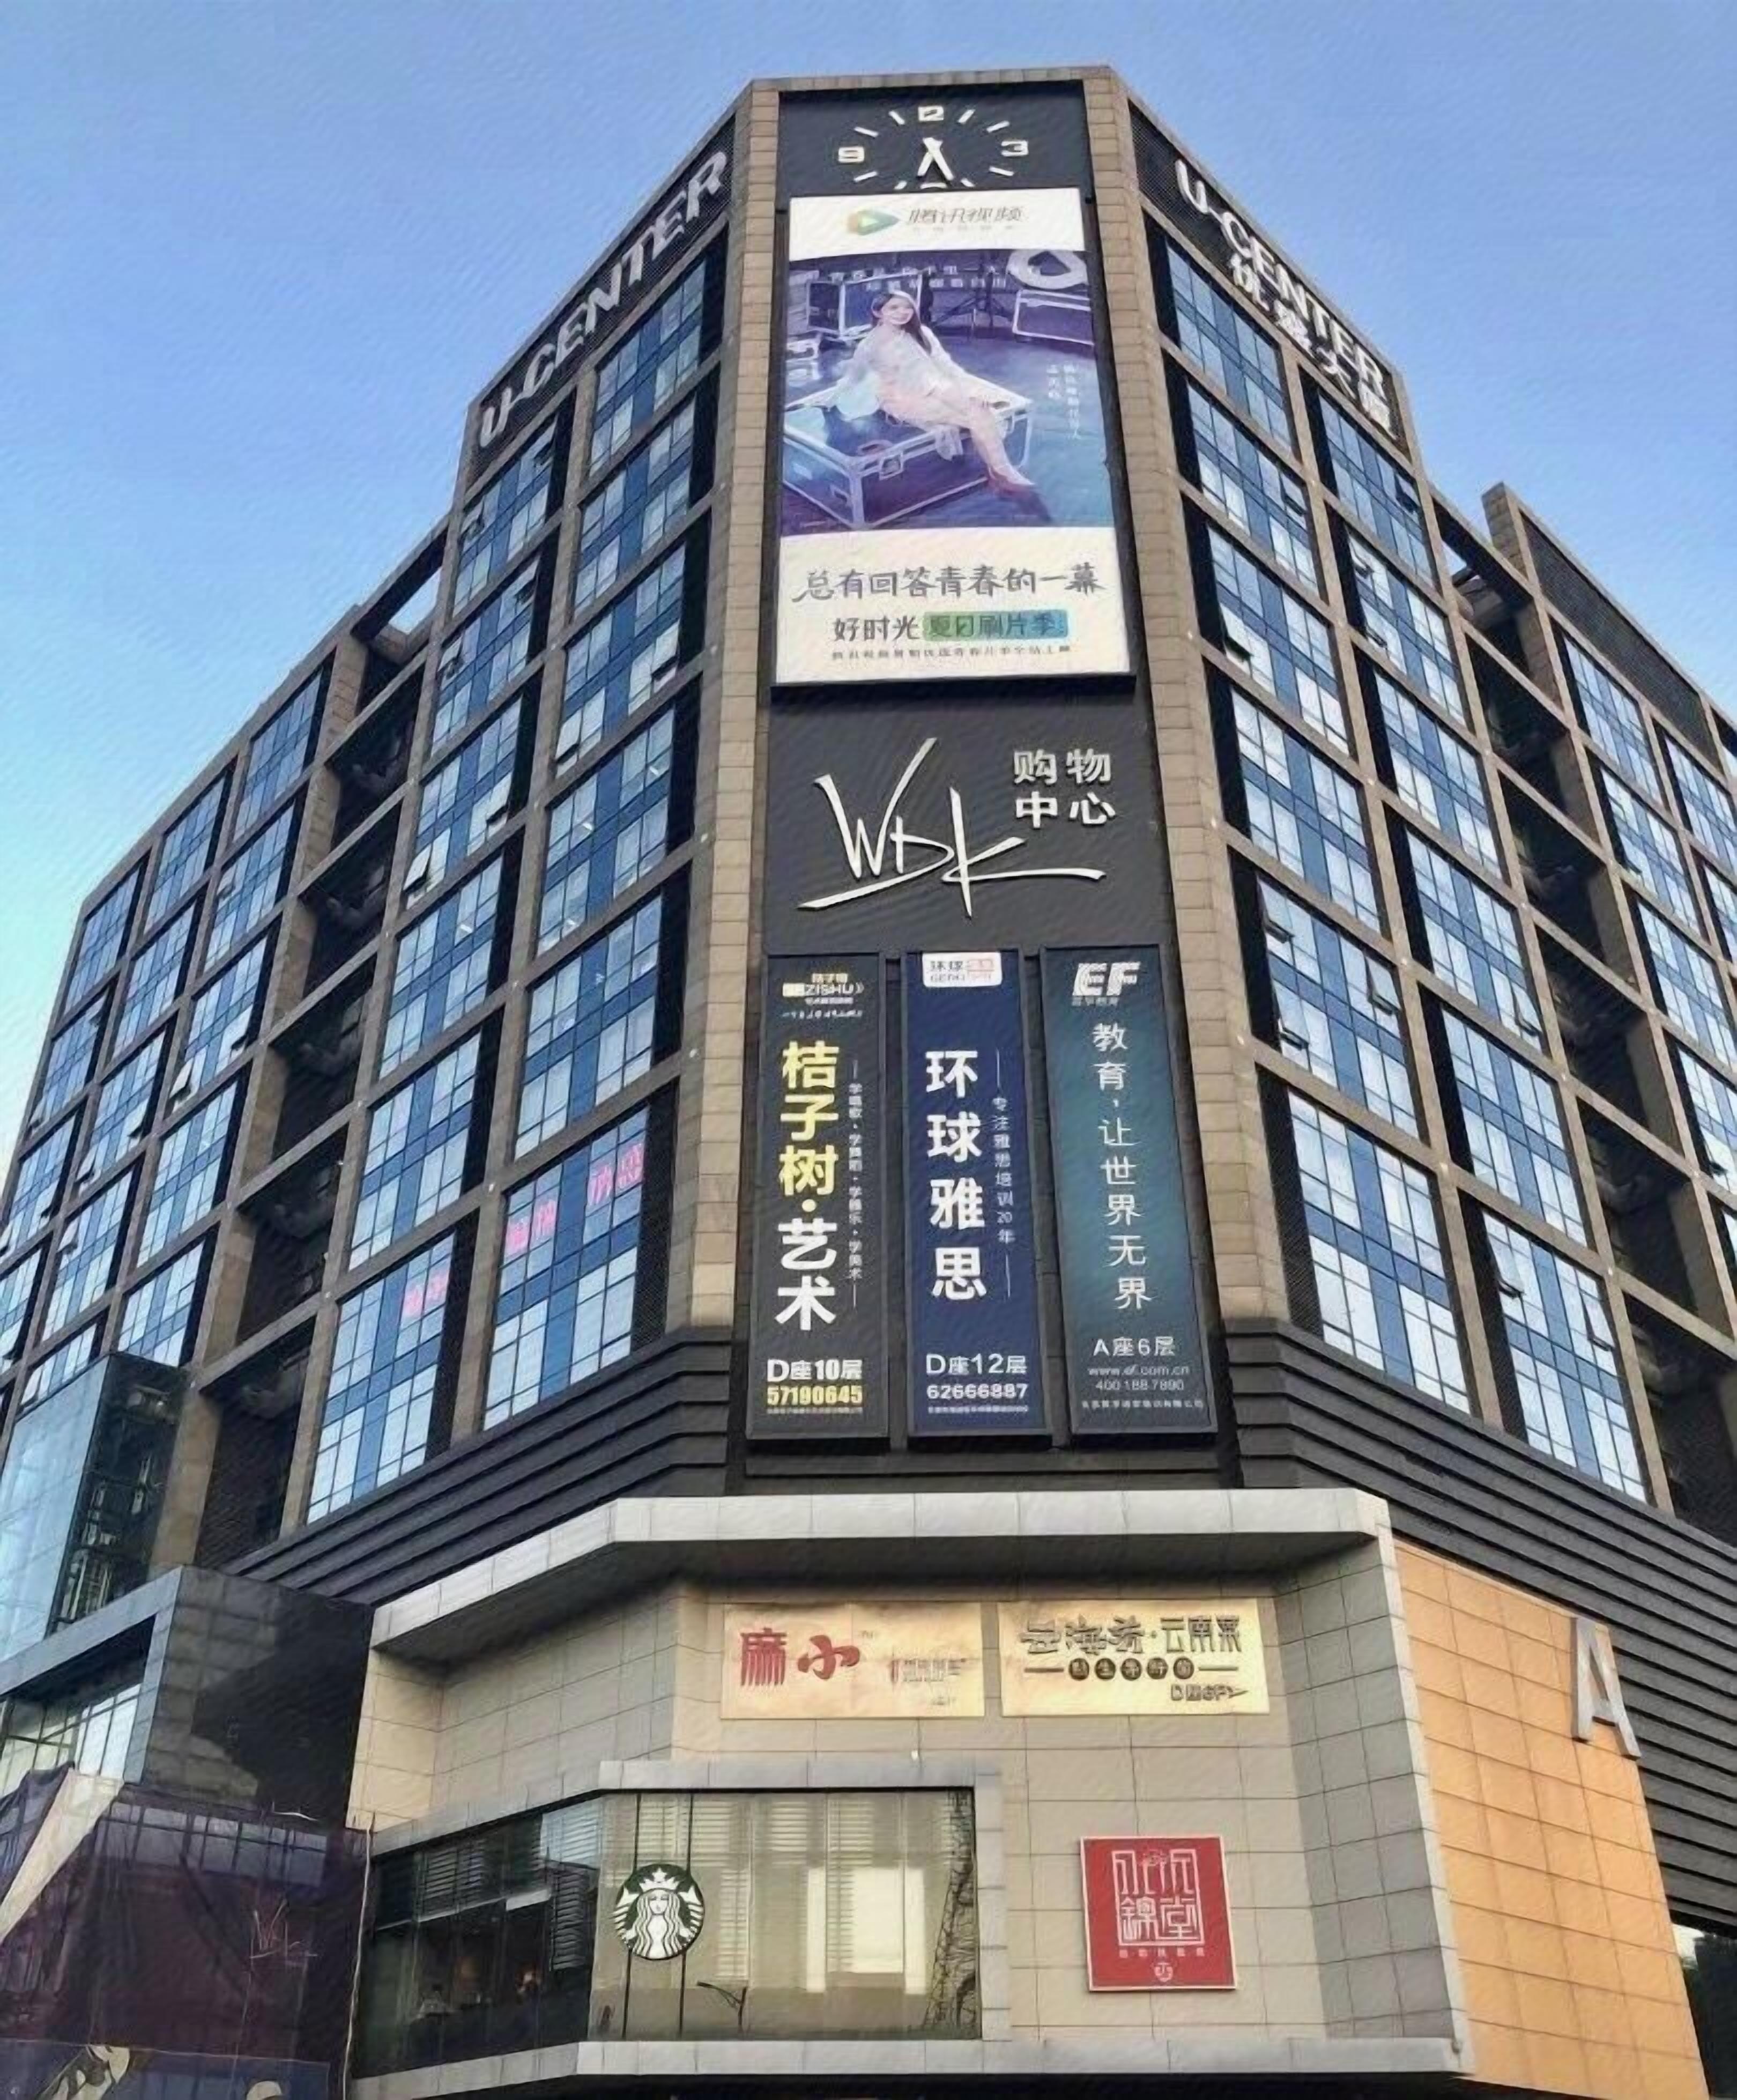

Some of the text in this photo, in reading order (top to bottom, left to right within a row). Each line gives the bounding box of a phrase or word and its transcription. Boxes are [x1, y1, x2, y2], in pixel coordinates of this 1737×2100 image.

[1000, 139, 1029, 156] 3
[792, 562, 1106, 603] 总有回答青春的一幕
[1012, 749, 1112, 785] 购物
[1015, 790, 1116, 829] 中心
[1072, 961, 1141, 996] EF
[925, 1050, 987, 1300] 环球雅思
[926, 1352, 1027, 1375] D座12层
[1093, 1336, 1175, 1356] A座6层
[767, 1358, 863, 1382] D座10层
[1572, 1617, 1642, 1758] A
